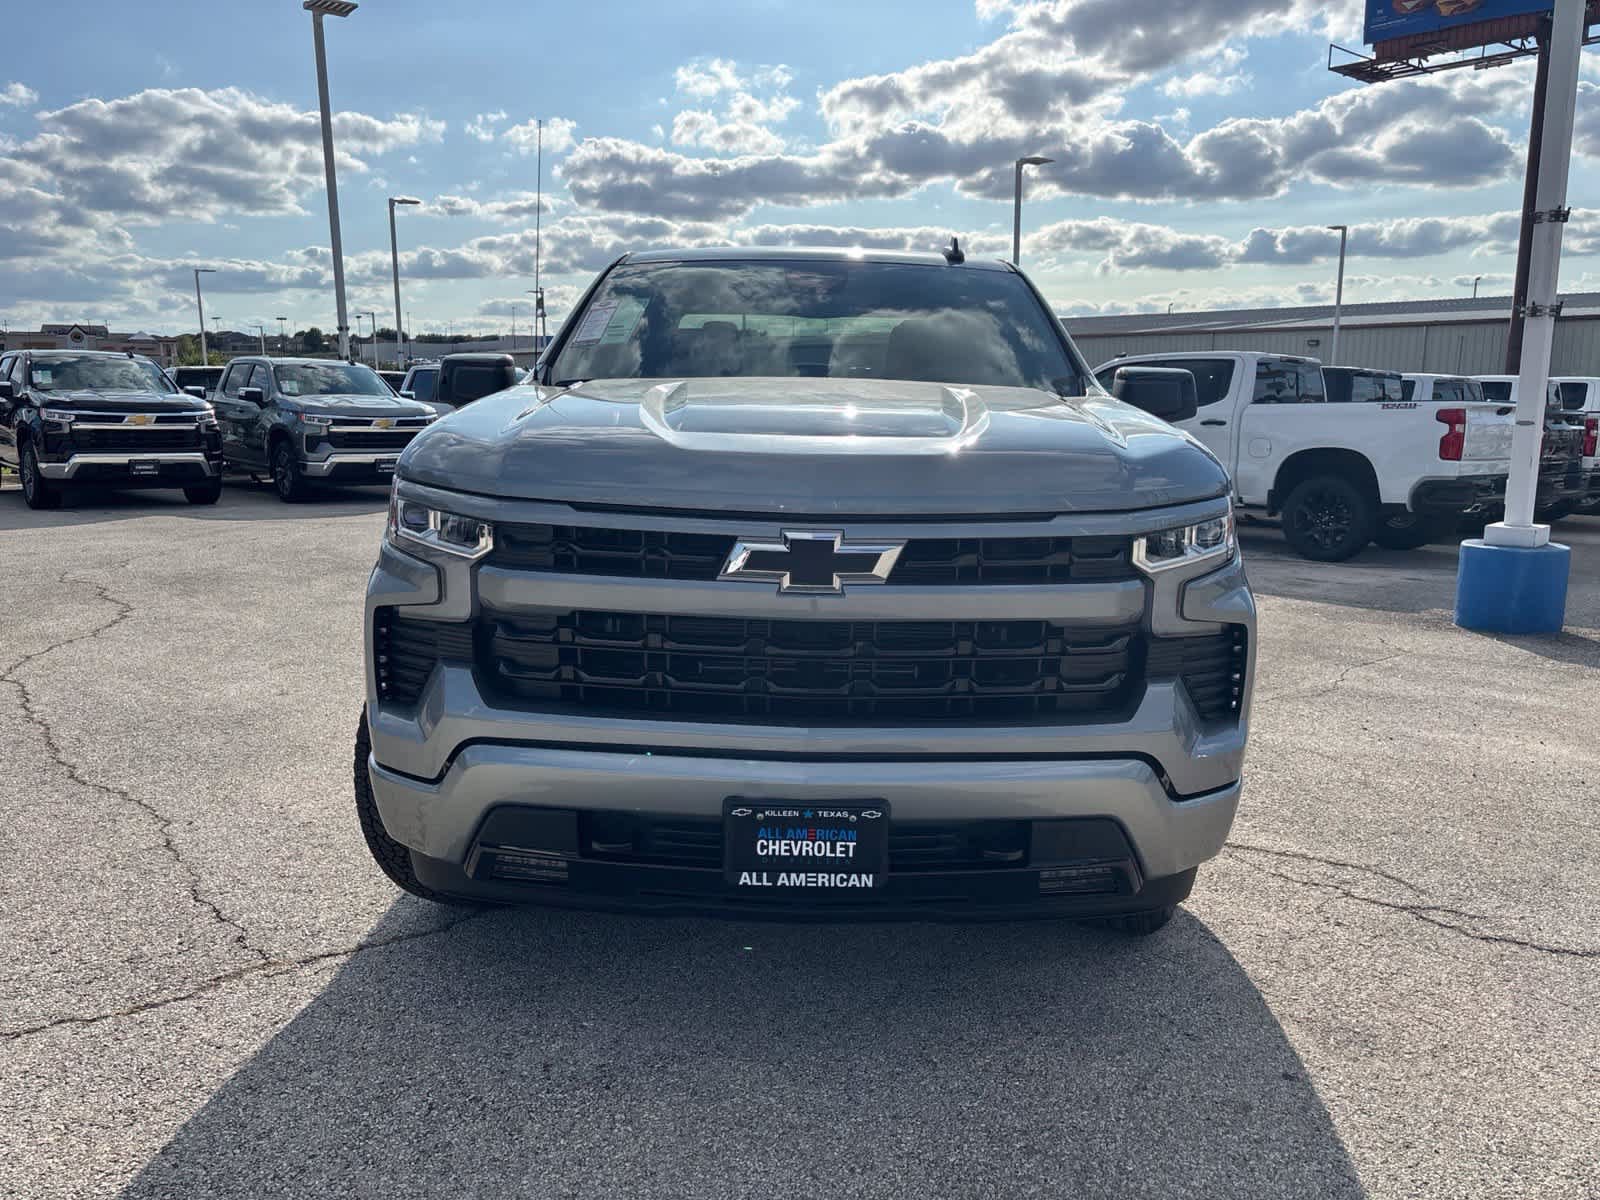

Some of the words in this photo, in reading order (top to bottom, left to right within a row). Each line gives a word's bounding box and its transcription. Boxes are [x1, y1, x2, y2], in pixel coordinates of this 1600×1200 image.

[758, 828, 782, 840] ALL
[786, 828, 857, 841] AMERICAN
[757, 840, 857, 857] CHEVROLET
[739, 872, 772, 886] ALL
[777, 873, 873, 887] AMERICAN
